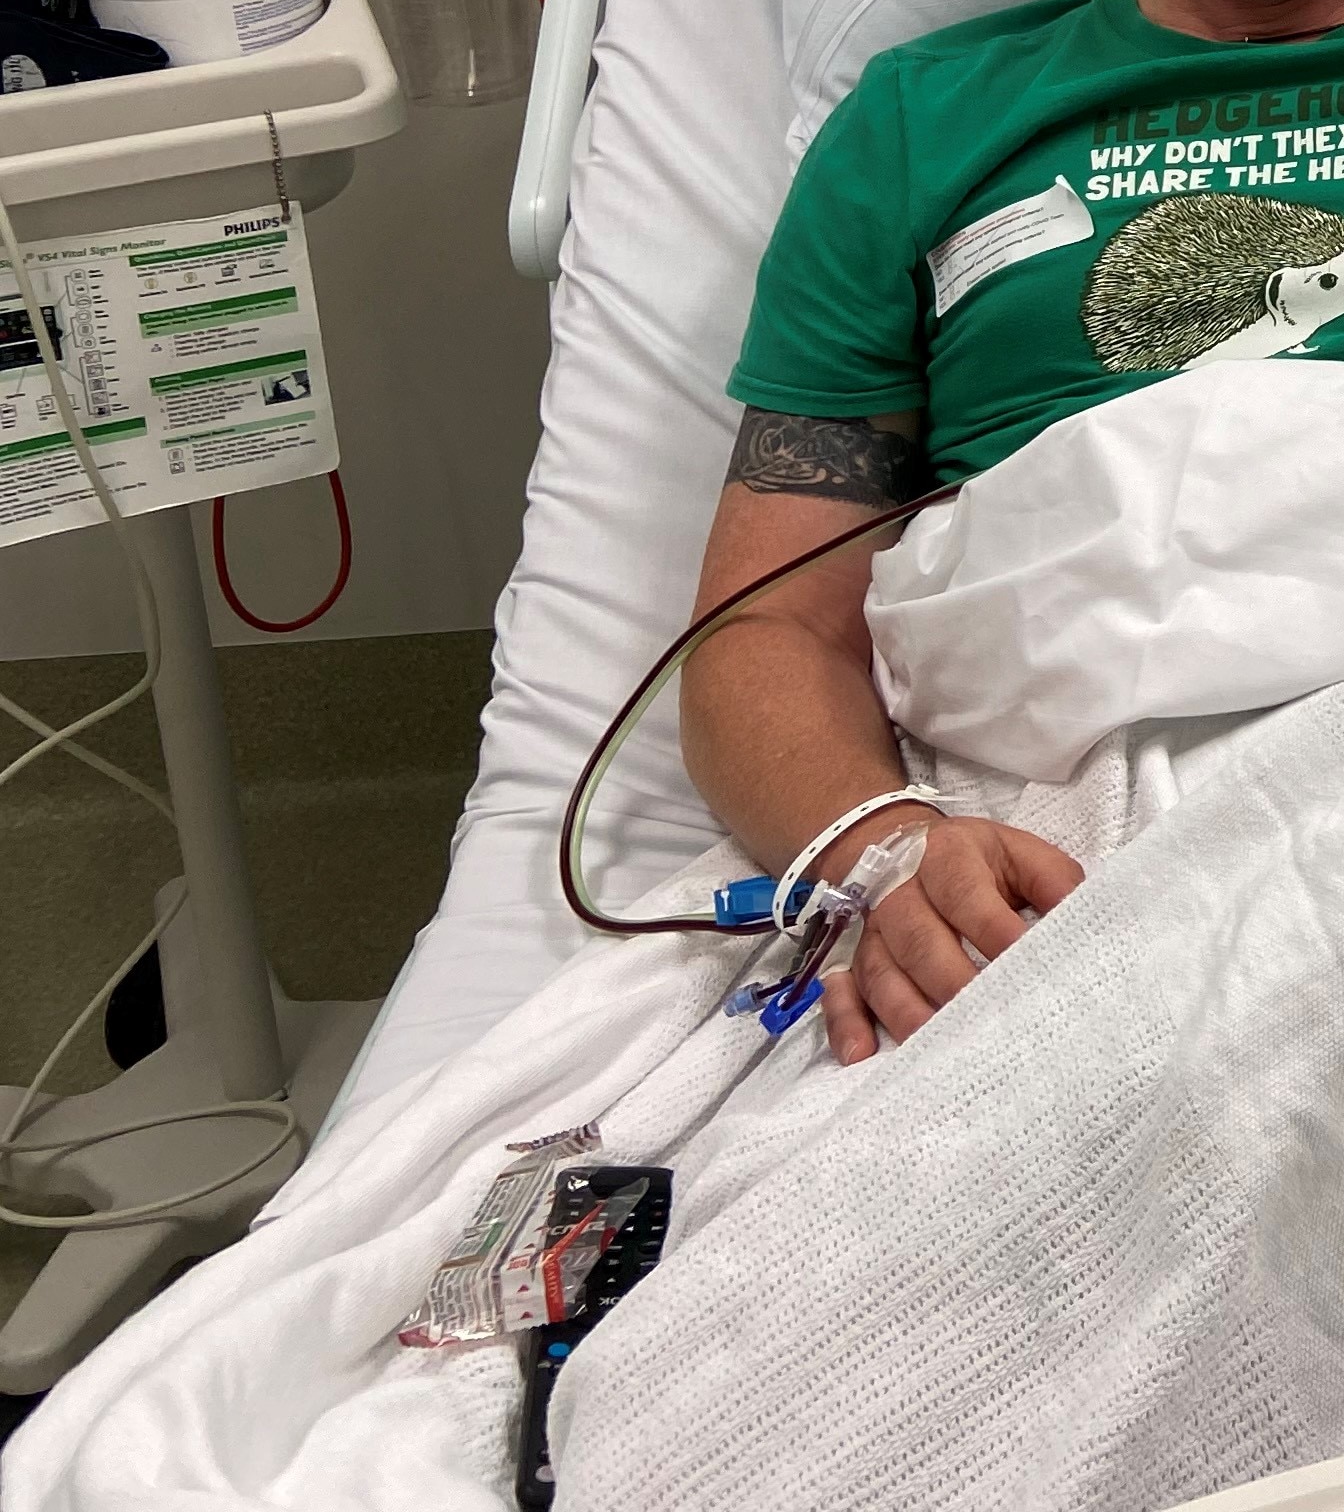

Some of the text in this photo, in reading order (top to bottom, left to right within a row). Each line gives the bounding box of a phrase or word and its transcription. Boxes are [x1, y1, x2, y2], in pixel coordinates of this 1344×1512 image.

[1090, 141, 1162, 171] WHY
[1164, 134, 1264, 165] DON'T
[1085, 167, 1215, 201] SHARE
[1225, 161, 1299, 188] THE
[224, 217, 280, 236] PHILIPS
[90, 246, 118, 256] Signs
[120, 239, 167, 252] Monitor
